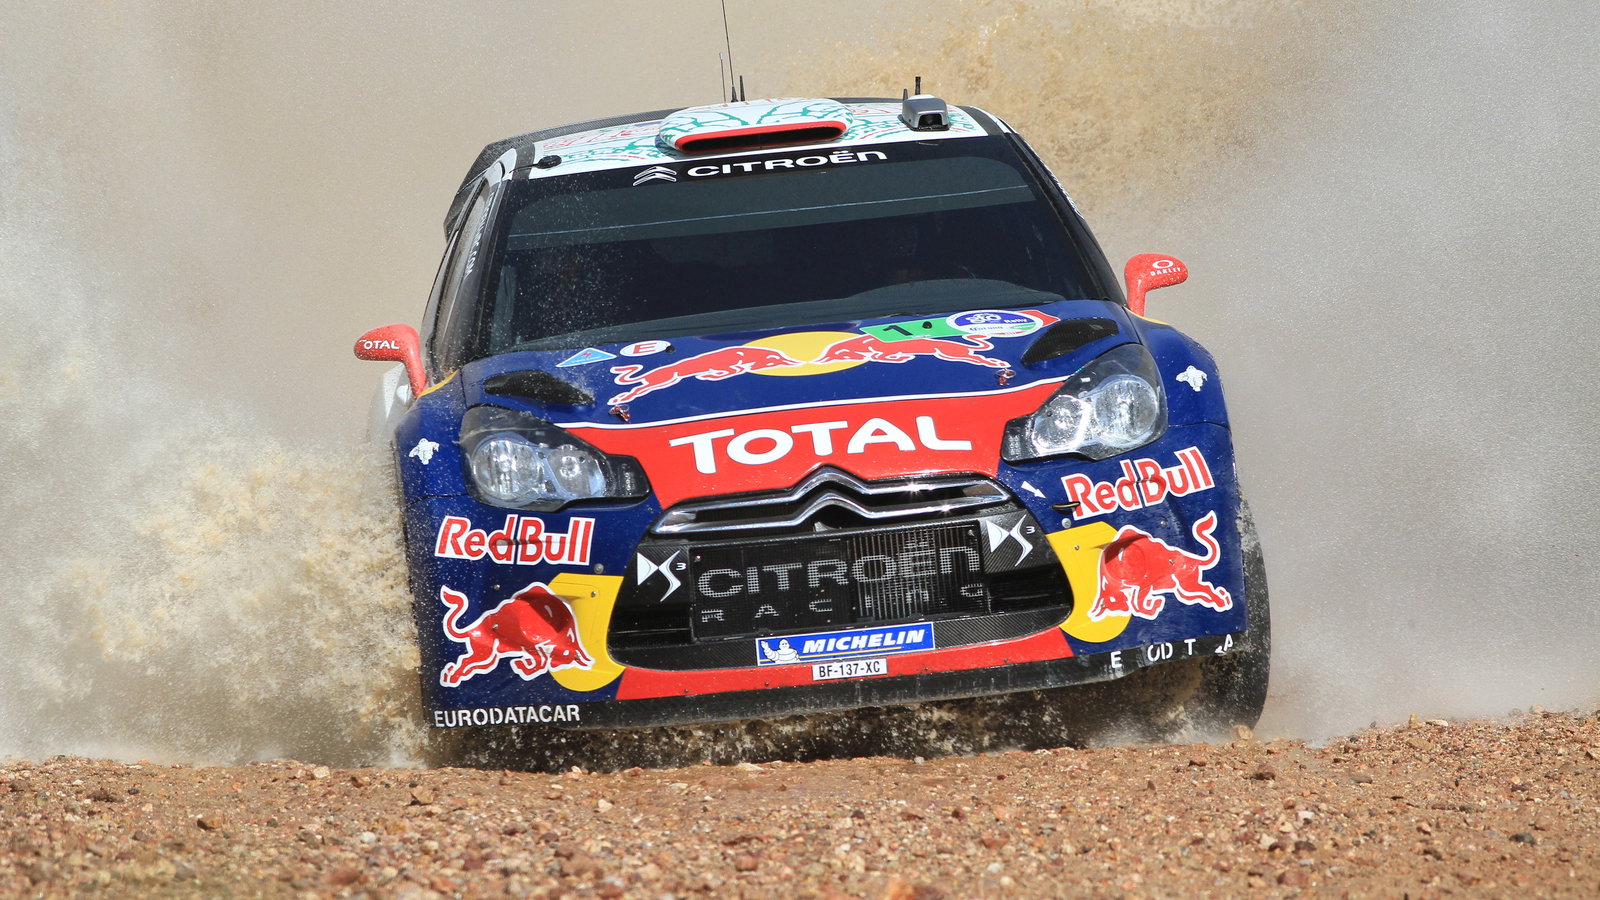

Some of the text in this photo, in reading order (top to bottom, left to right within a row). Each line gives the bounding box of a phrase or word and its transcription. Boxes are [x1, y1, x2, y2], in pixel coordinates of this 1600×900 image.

[1150, 267, 1181, 277] OAKLEY
[882, 325, 913, 336] 1
[633, 342, 658, 355] E
[669, 416, 973, 475] TOTAL
[802, 629, 925, 654] MICHELIN
[819, 660, 881, 678] BF-137-XC
[434, 704, 581, 728] EURODATACAR
